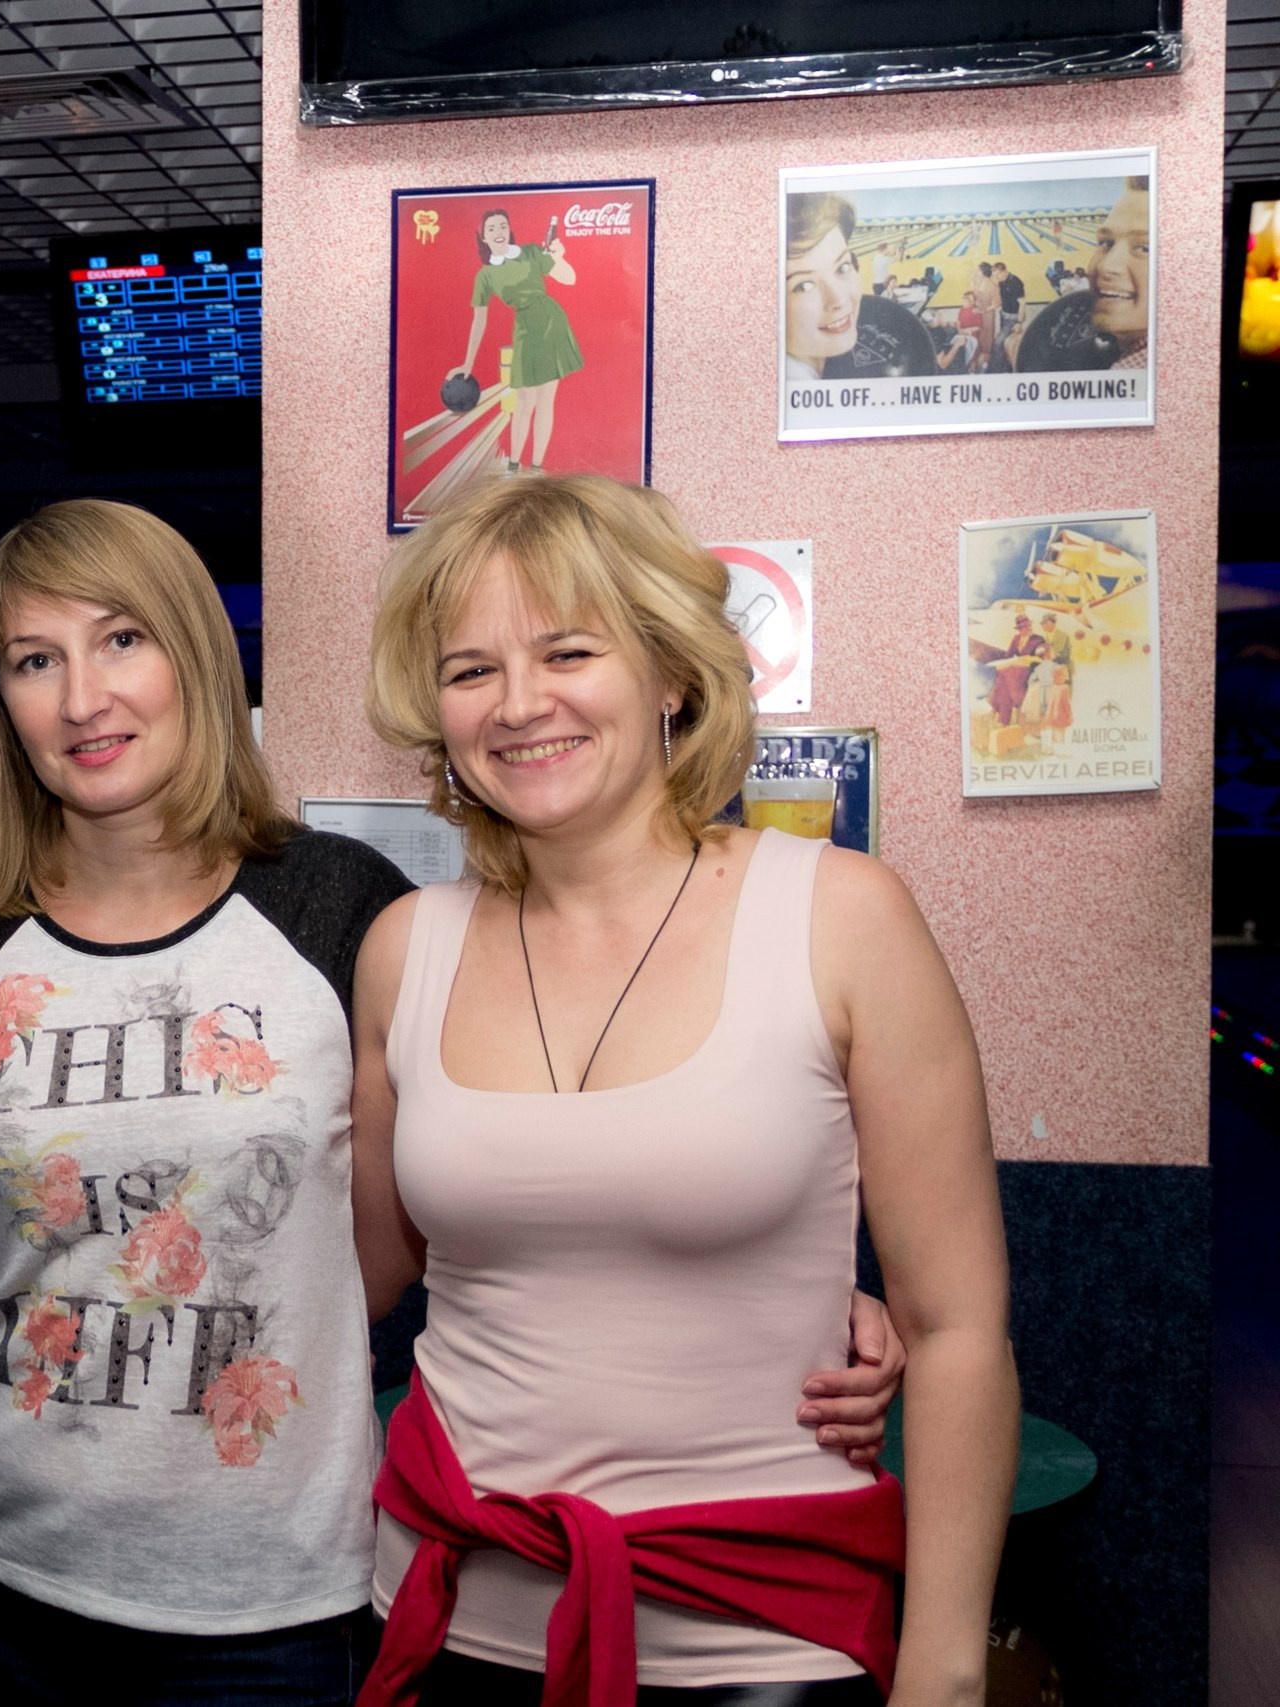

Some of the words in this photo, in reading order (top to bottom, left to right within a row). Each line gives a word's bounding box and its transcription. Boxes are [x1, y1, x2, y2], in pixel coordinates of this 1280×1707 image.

[725, 70, 739, 79] LG
[565, 229, 594, 237] ENJOY
[613, 227, 631, 235] FUN
[84, 283, 94, 295] 3
[95, 294, 109, 307] 3
[790, 389, 834, 408] COOL
[900, 385, 942, 405] HAVE
[1016, 382, 1040, 401] GO
[1048, 379, 1136, 400] BOWLING!
[1094, 744, 1127, 753] ROMA
[971, 762, 1068, 782] SERVIZI
[1075, 760, 1153, 778] AEREI
